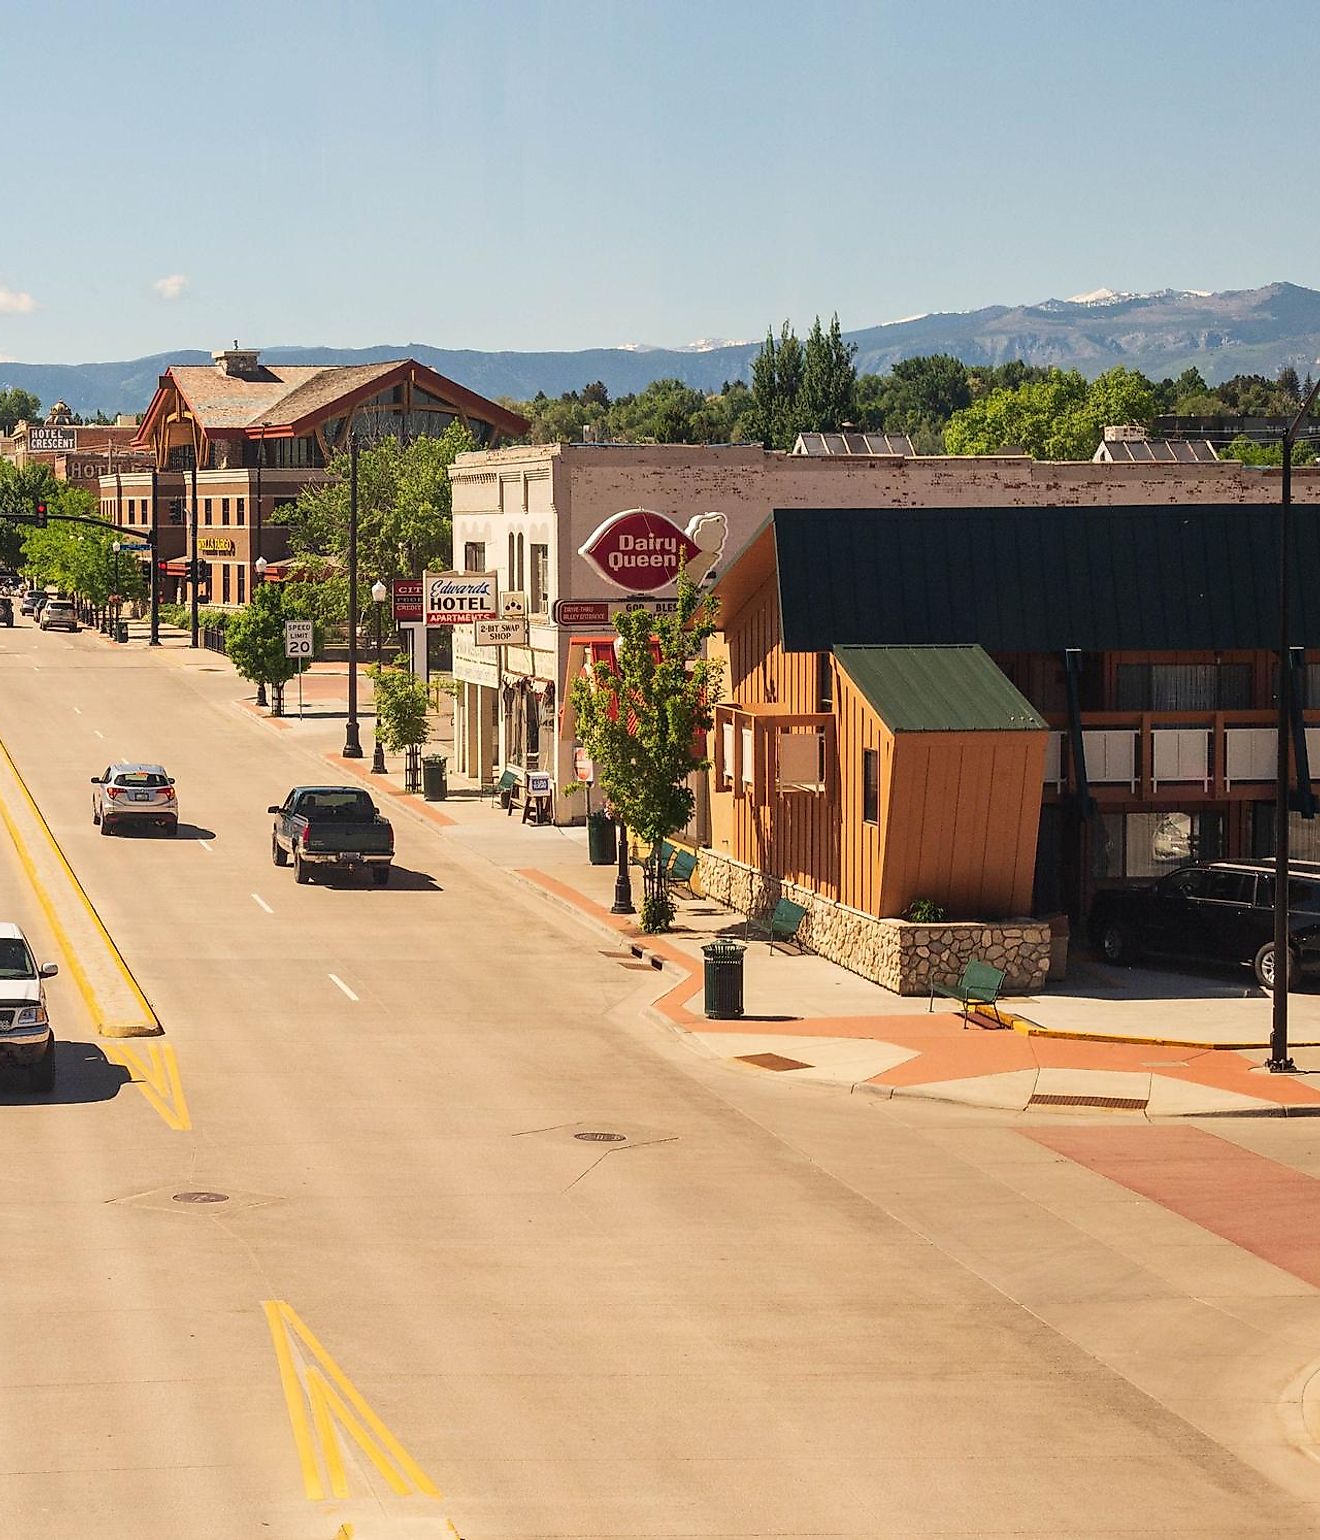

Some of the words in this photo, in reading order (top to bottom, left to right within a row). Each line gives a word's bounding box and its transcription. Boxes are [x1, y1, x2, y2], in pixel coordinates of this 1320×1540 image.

[31, 430, 63, 438] HOTEL
[31, 439, 75, 449] CRESCENT
[618, 532, 677, 553] Dairy
[608, 552, 676, 572] Queen
[430, 580, 491, 597] Edwards
[430, 597, 491, 611] HOTEL
[655, 603, 678, 613] BLES
[431, 614, 491, 622] APARTMENTS
[501, 624, 520, 632] SWAP
[489, 633, 512, 641] SHOP
[290, 641, 310, 653] 20
